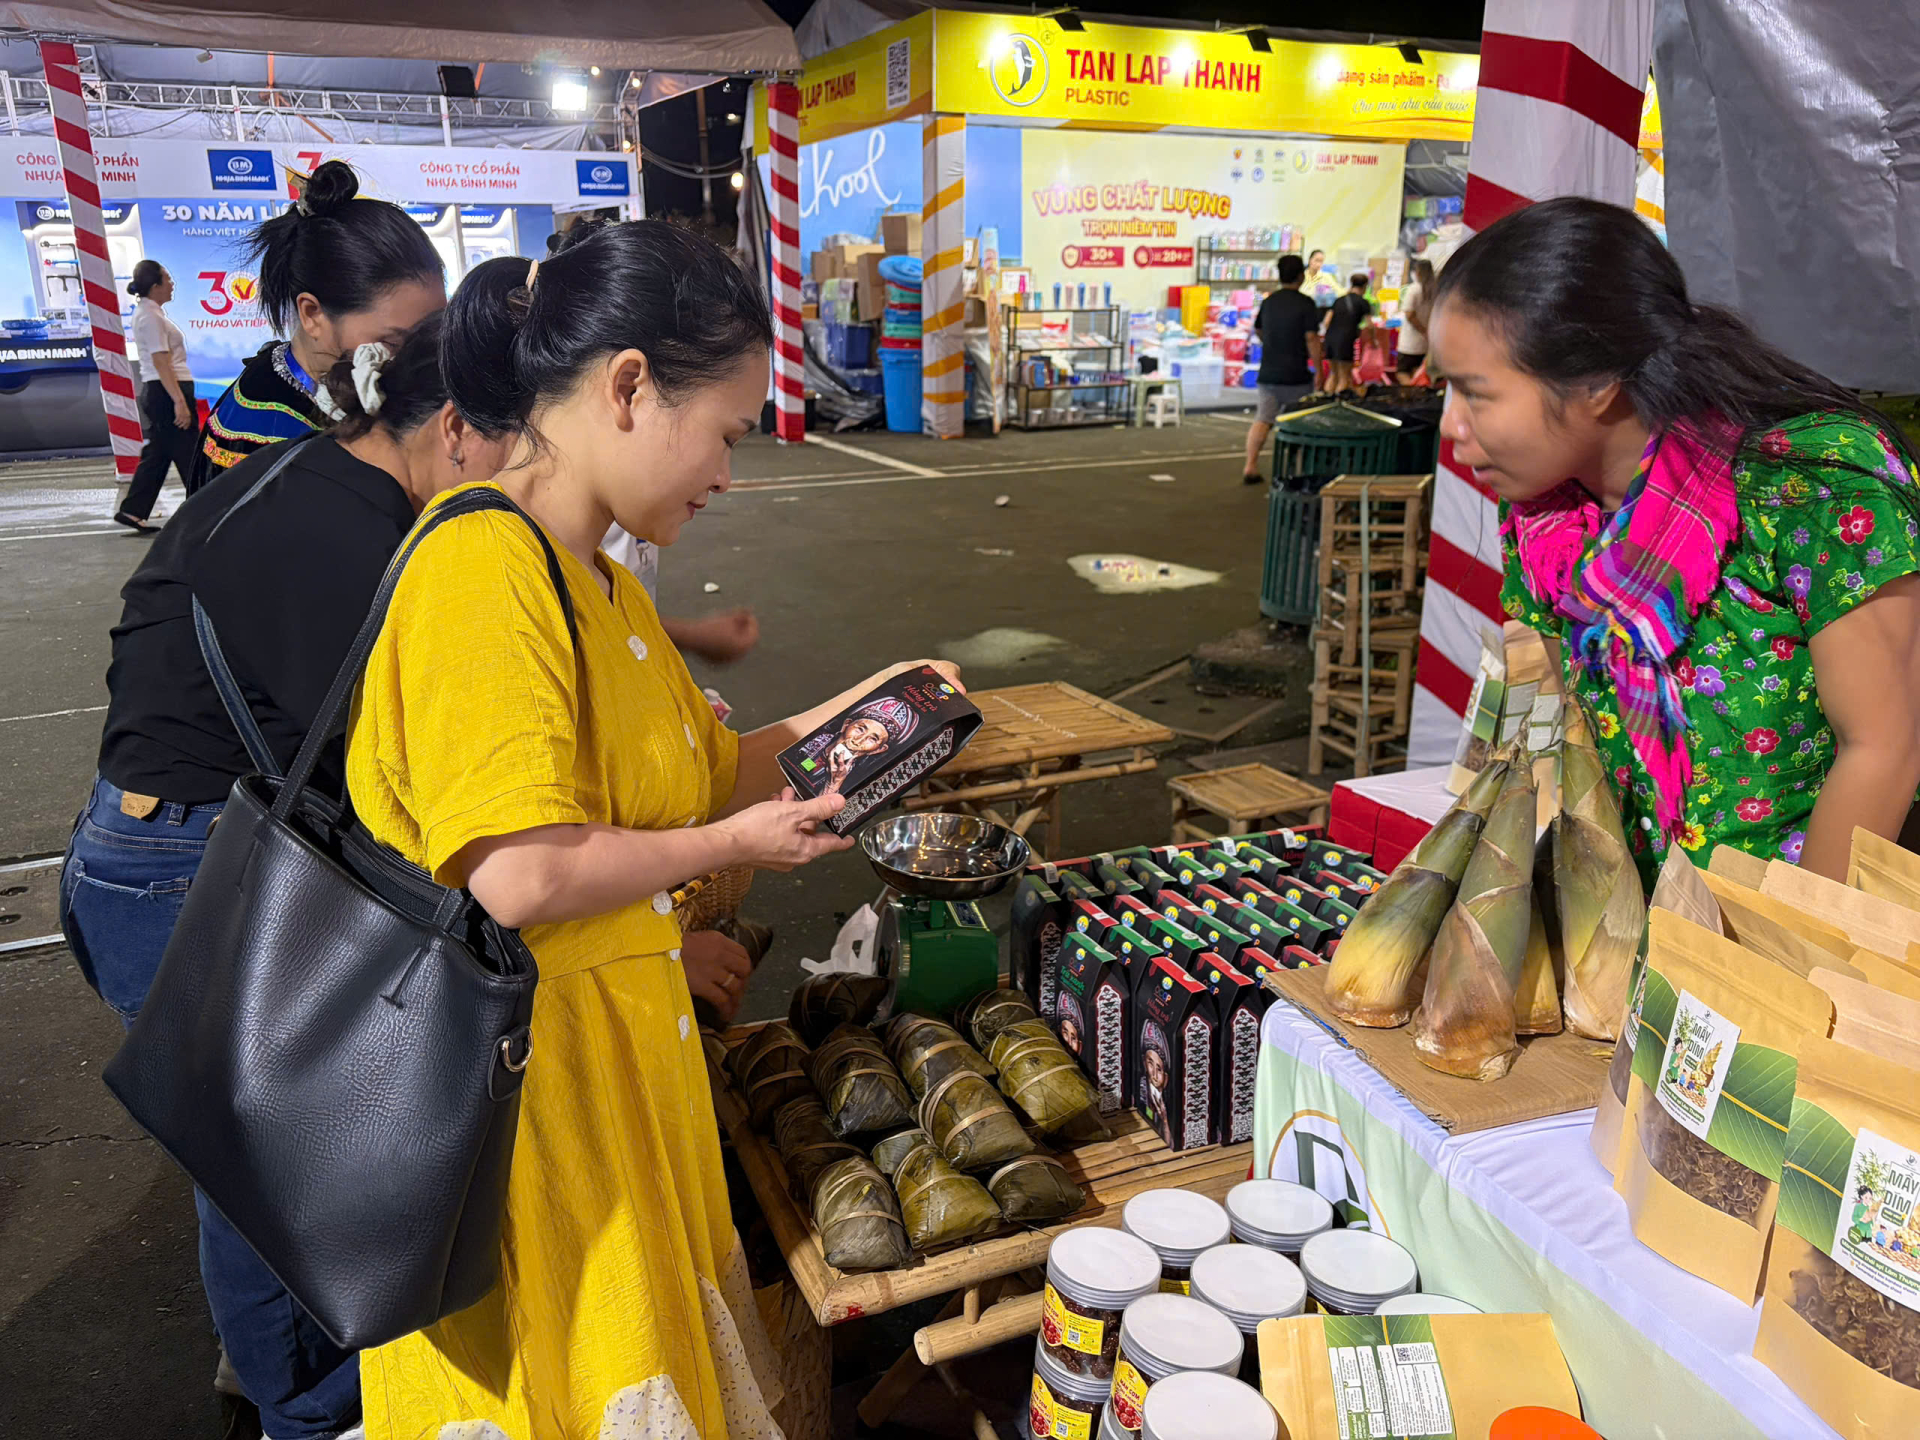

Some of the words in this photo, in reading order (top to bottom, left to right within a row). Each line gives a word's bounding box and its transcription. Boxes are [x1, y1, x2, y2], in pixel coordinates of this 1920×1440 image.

[1067, 49, 1115, 82] TAN
[1125, 53, 1171, 86] LAP
[806, 83, 823, 109] LAP
[825, 71, 857, 103] THANH
[1065, 88, 1130, 106] PLASTIC
[16, 152, 57, 166] CÔNG
[103, 152, 139, 167] PHẦN
[420, 162, 453, 174] CÔNG
[456, 163, 469, 174] TY
[25, 171, 63, 184] NHỰA
[101, 172, 136, 182] MINH
[426, 178, 458, 191] NHỰA
[461, 176, 487, 189] BÌNH
[489, 179, 518, 189] MINH
[162, 205, 192, 221] 30
[198, 202, 254, 221] NĂM
[1162, 187, 1231, 219] LƯỢNG
[183, 227, 213, 236] HÀNG
[214, 227, 236, 237] VIỆT
[1153, 221, 1177, 238] TIN
[1089, 248, 1115, 261] 30+
[925, 683, 949, 701] OCOP
